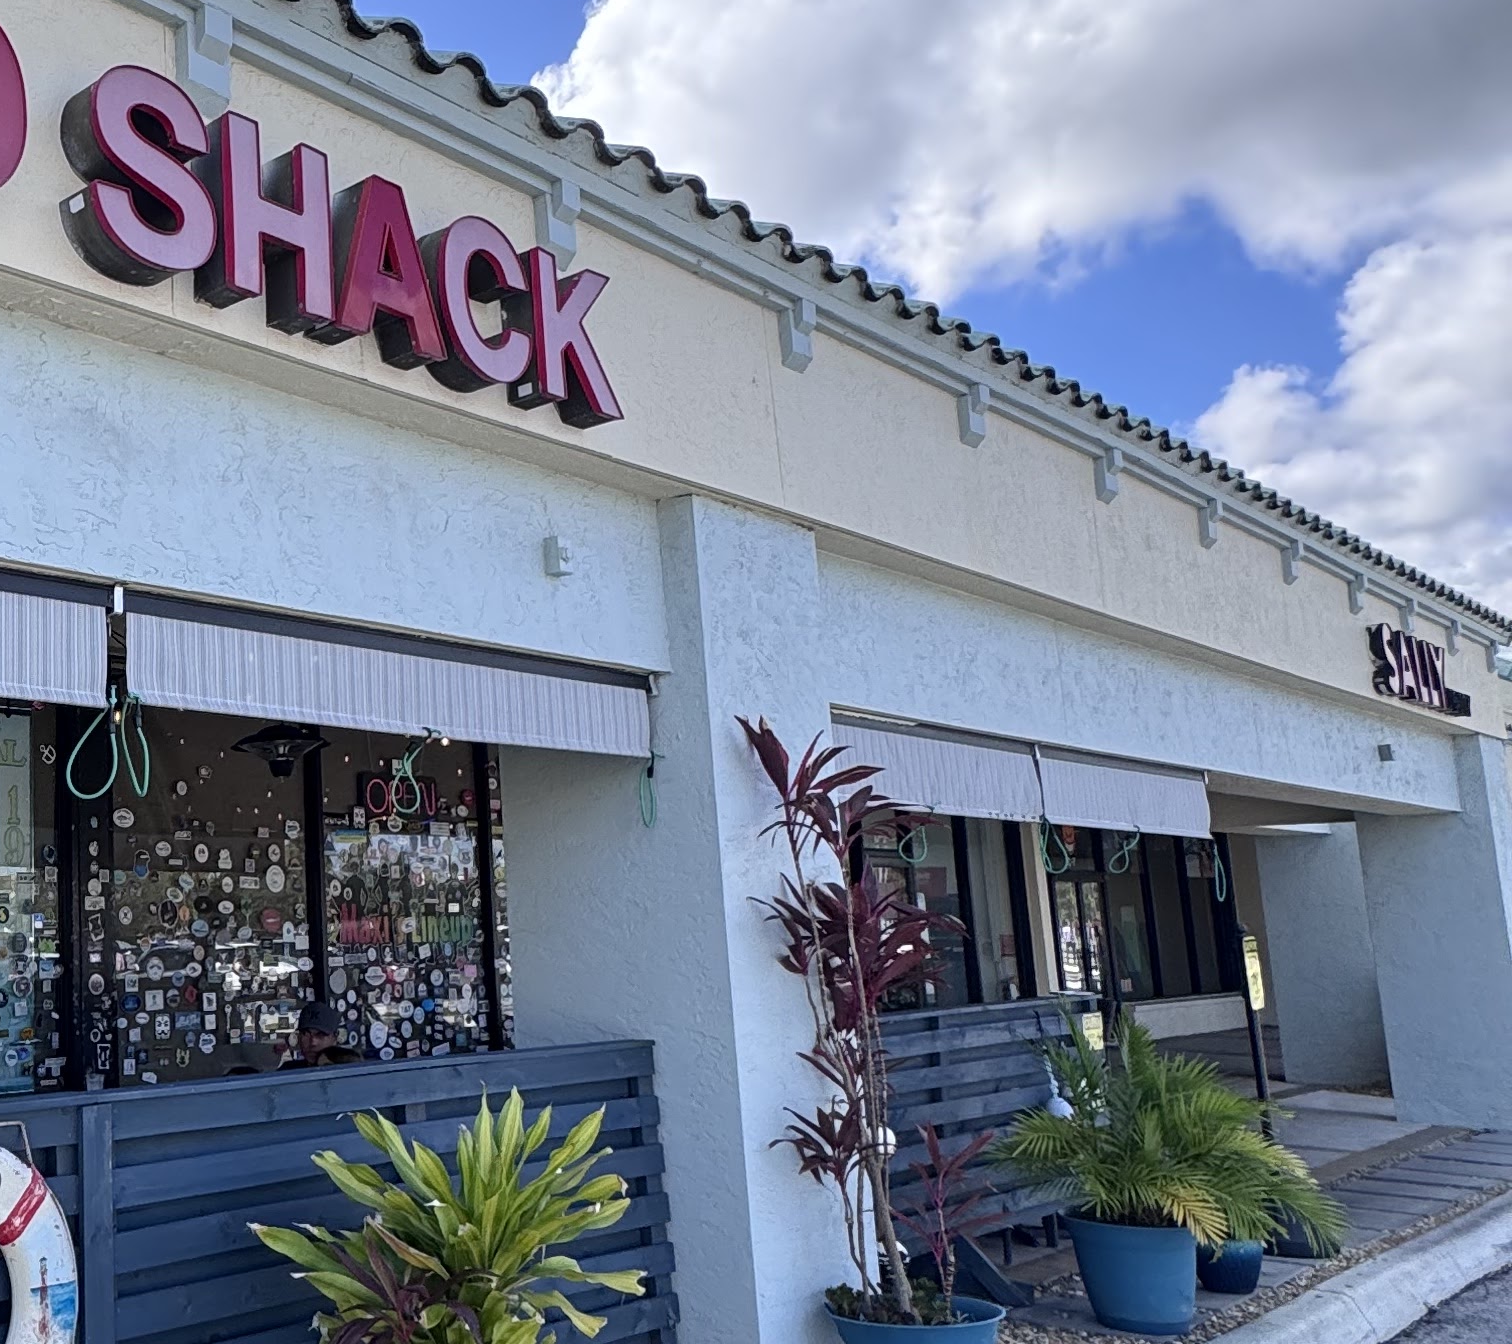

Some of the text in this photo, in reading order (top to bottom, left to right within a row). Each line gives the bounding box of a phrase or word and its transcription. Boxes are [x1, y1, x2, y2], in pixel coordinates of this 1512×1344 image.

[60, 64, 624, 429] SHACK
[366, 778, 437, 816] OPEN
[412, 910, 473, 945] Lineup
